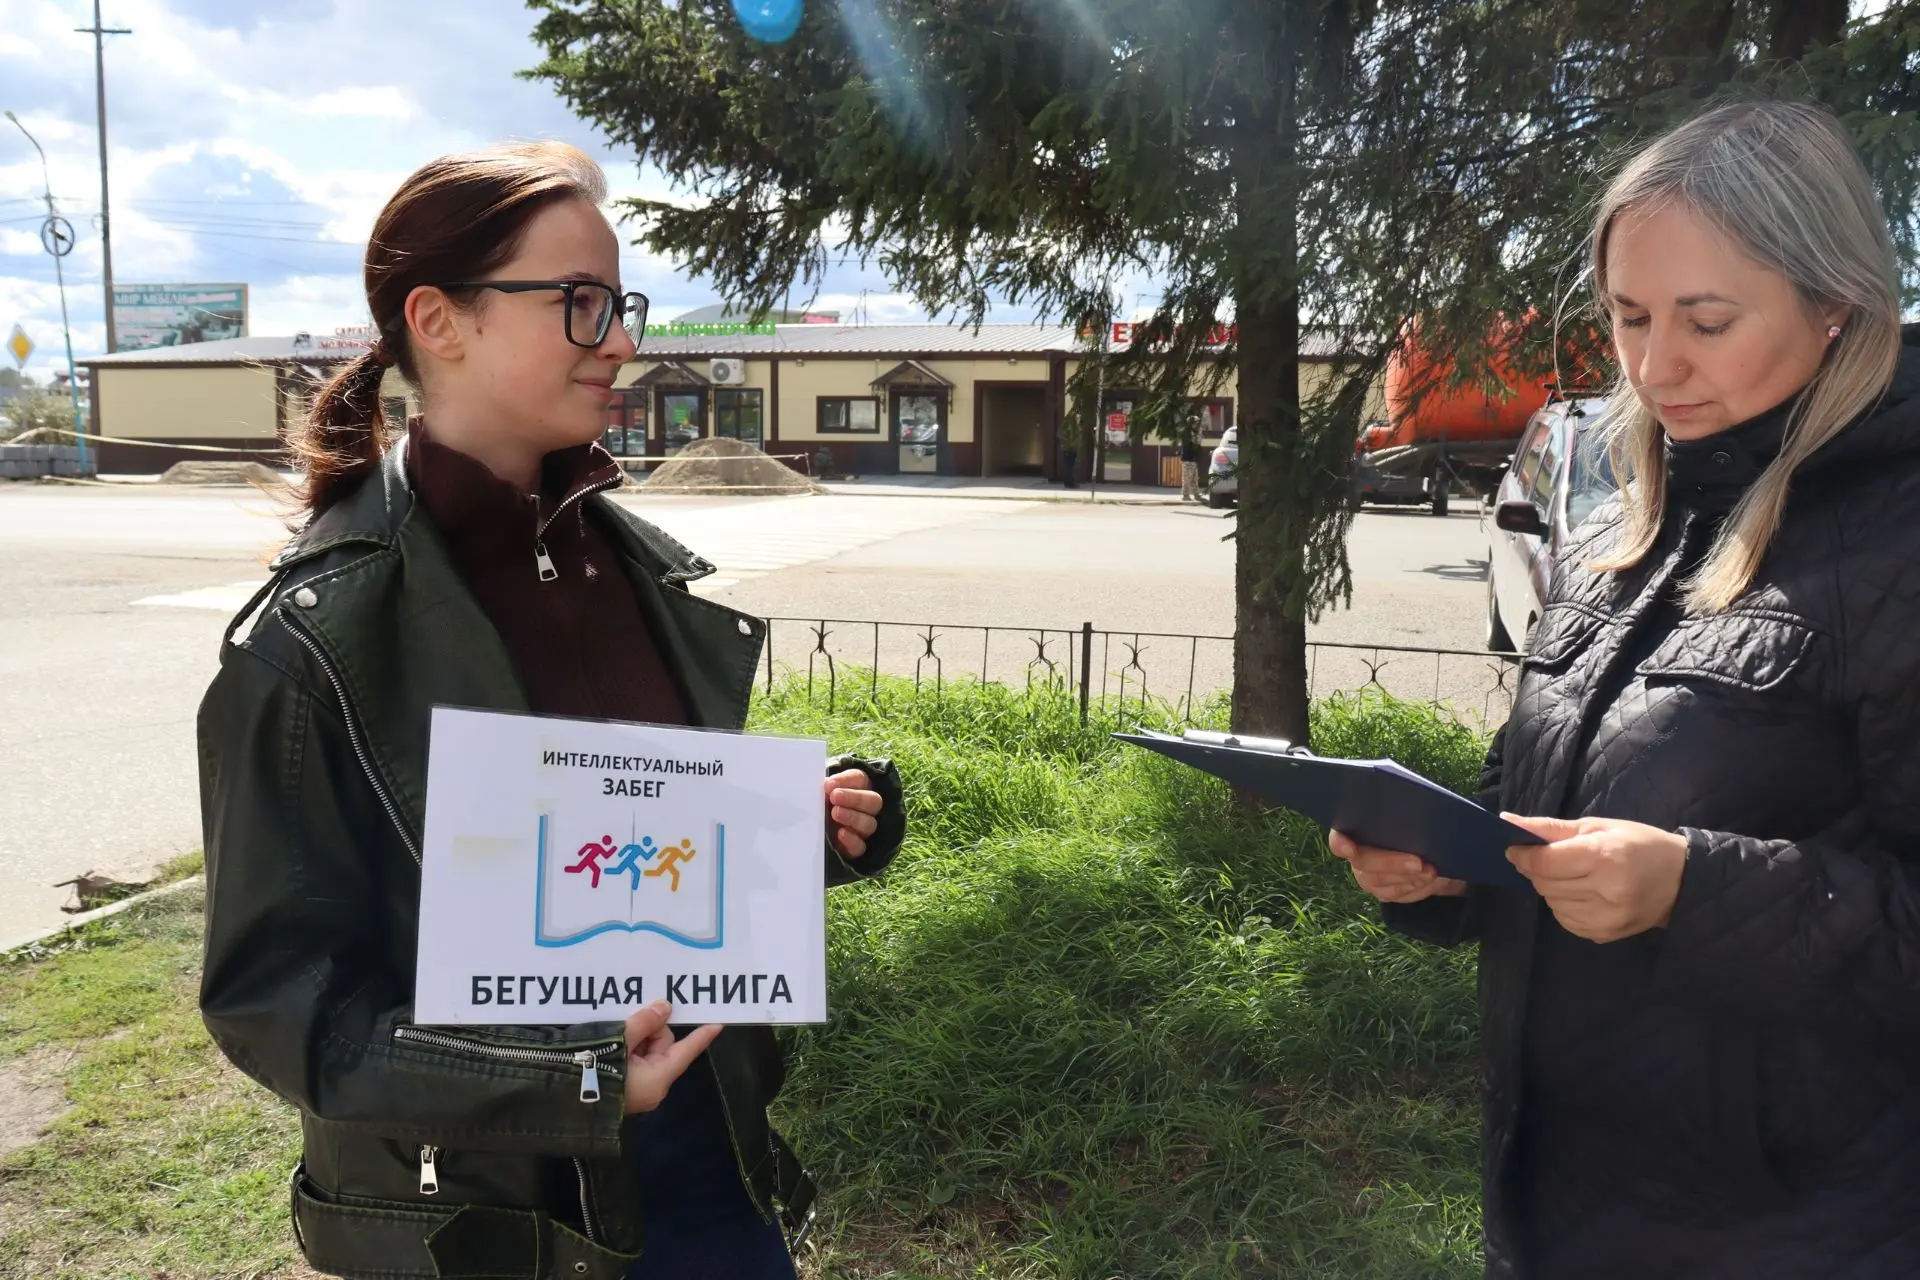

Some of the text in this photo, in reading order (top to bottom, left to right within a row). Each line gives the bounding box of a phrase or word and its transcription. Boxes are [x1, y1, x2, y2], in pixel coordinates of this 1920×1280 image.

[543, 750, 724, 777] ИНТЕЛЛЕКТУАЛЬНЫЙ
[602, 777, 666, 798] ЗАБЕГ
[471, 974, 793, 1010] БЕГУЩАЯ КНИГА
